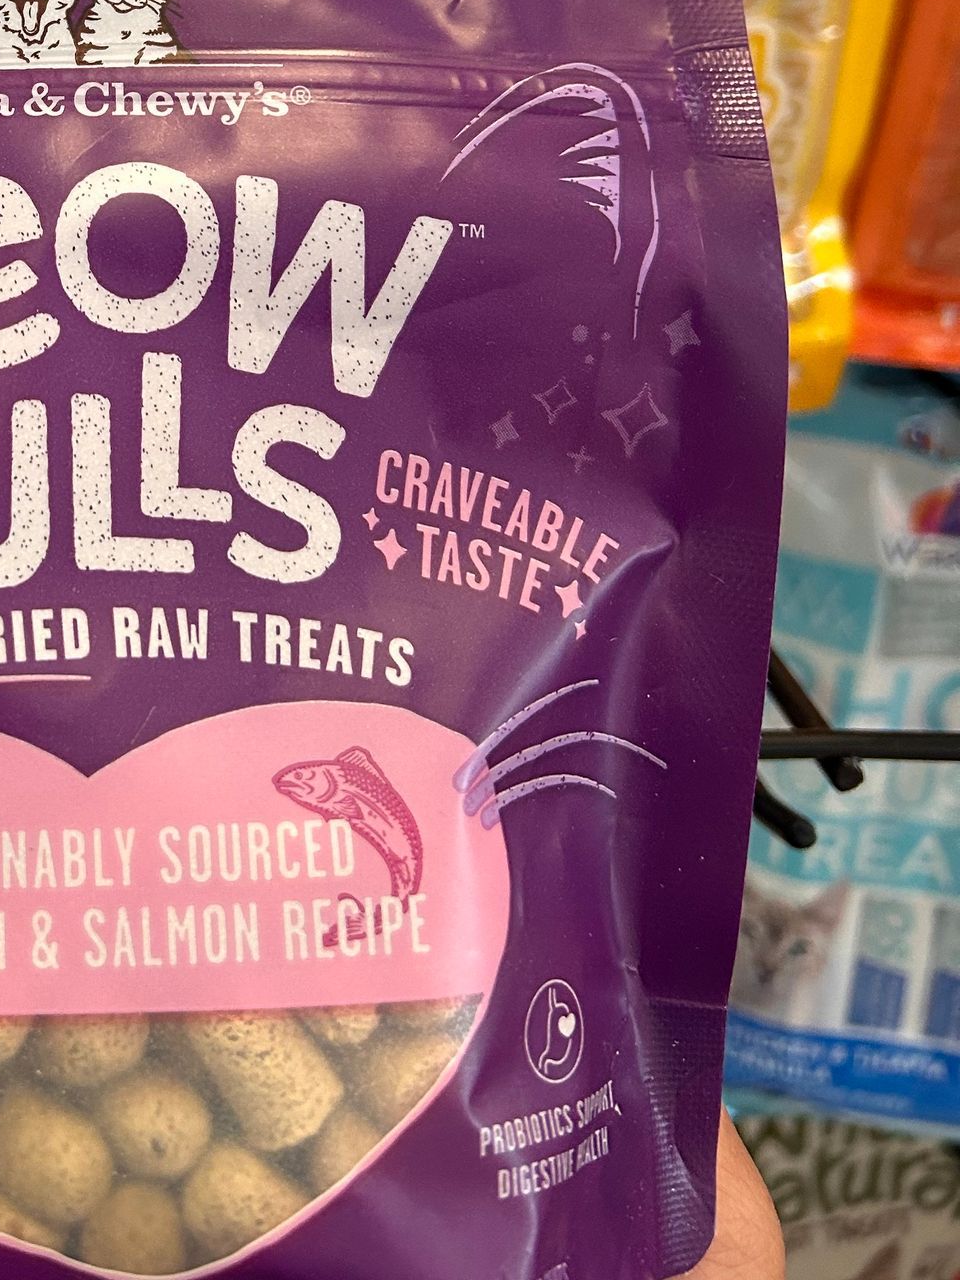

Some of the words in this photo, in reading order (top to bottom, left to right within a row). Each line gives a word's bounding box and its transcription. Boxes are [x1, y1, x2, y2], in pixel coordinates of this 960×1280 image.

[23, 82, 65, 117] &
[376, 449, 620, 584] CRAVEABLE
[416, 523, 550, 613] TASTE
[113, 606, 209, 660] RAW
[232, 610, 416, 688] TREATS
[158, 818, 355, 886] SOURCED
[31, 910, 60, 970] &
[82, 902, 260, 969] SALMON
[284, 893, 431, 960] RECIPE
[480, 1104, 574, 1158] PROBIOTICS
[497, 1148, 574, 1199] DIGESTIVE
